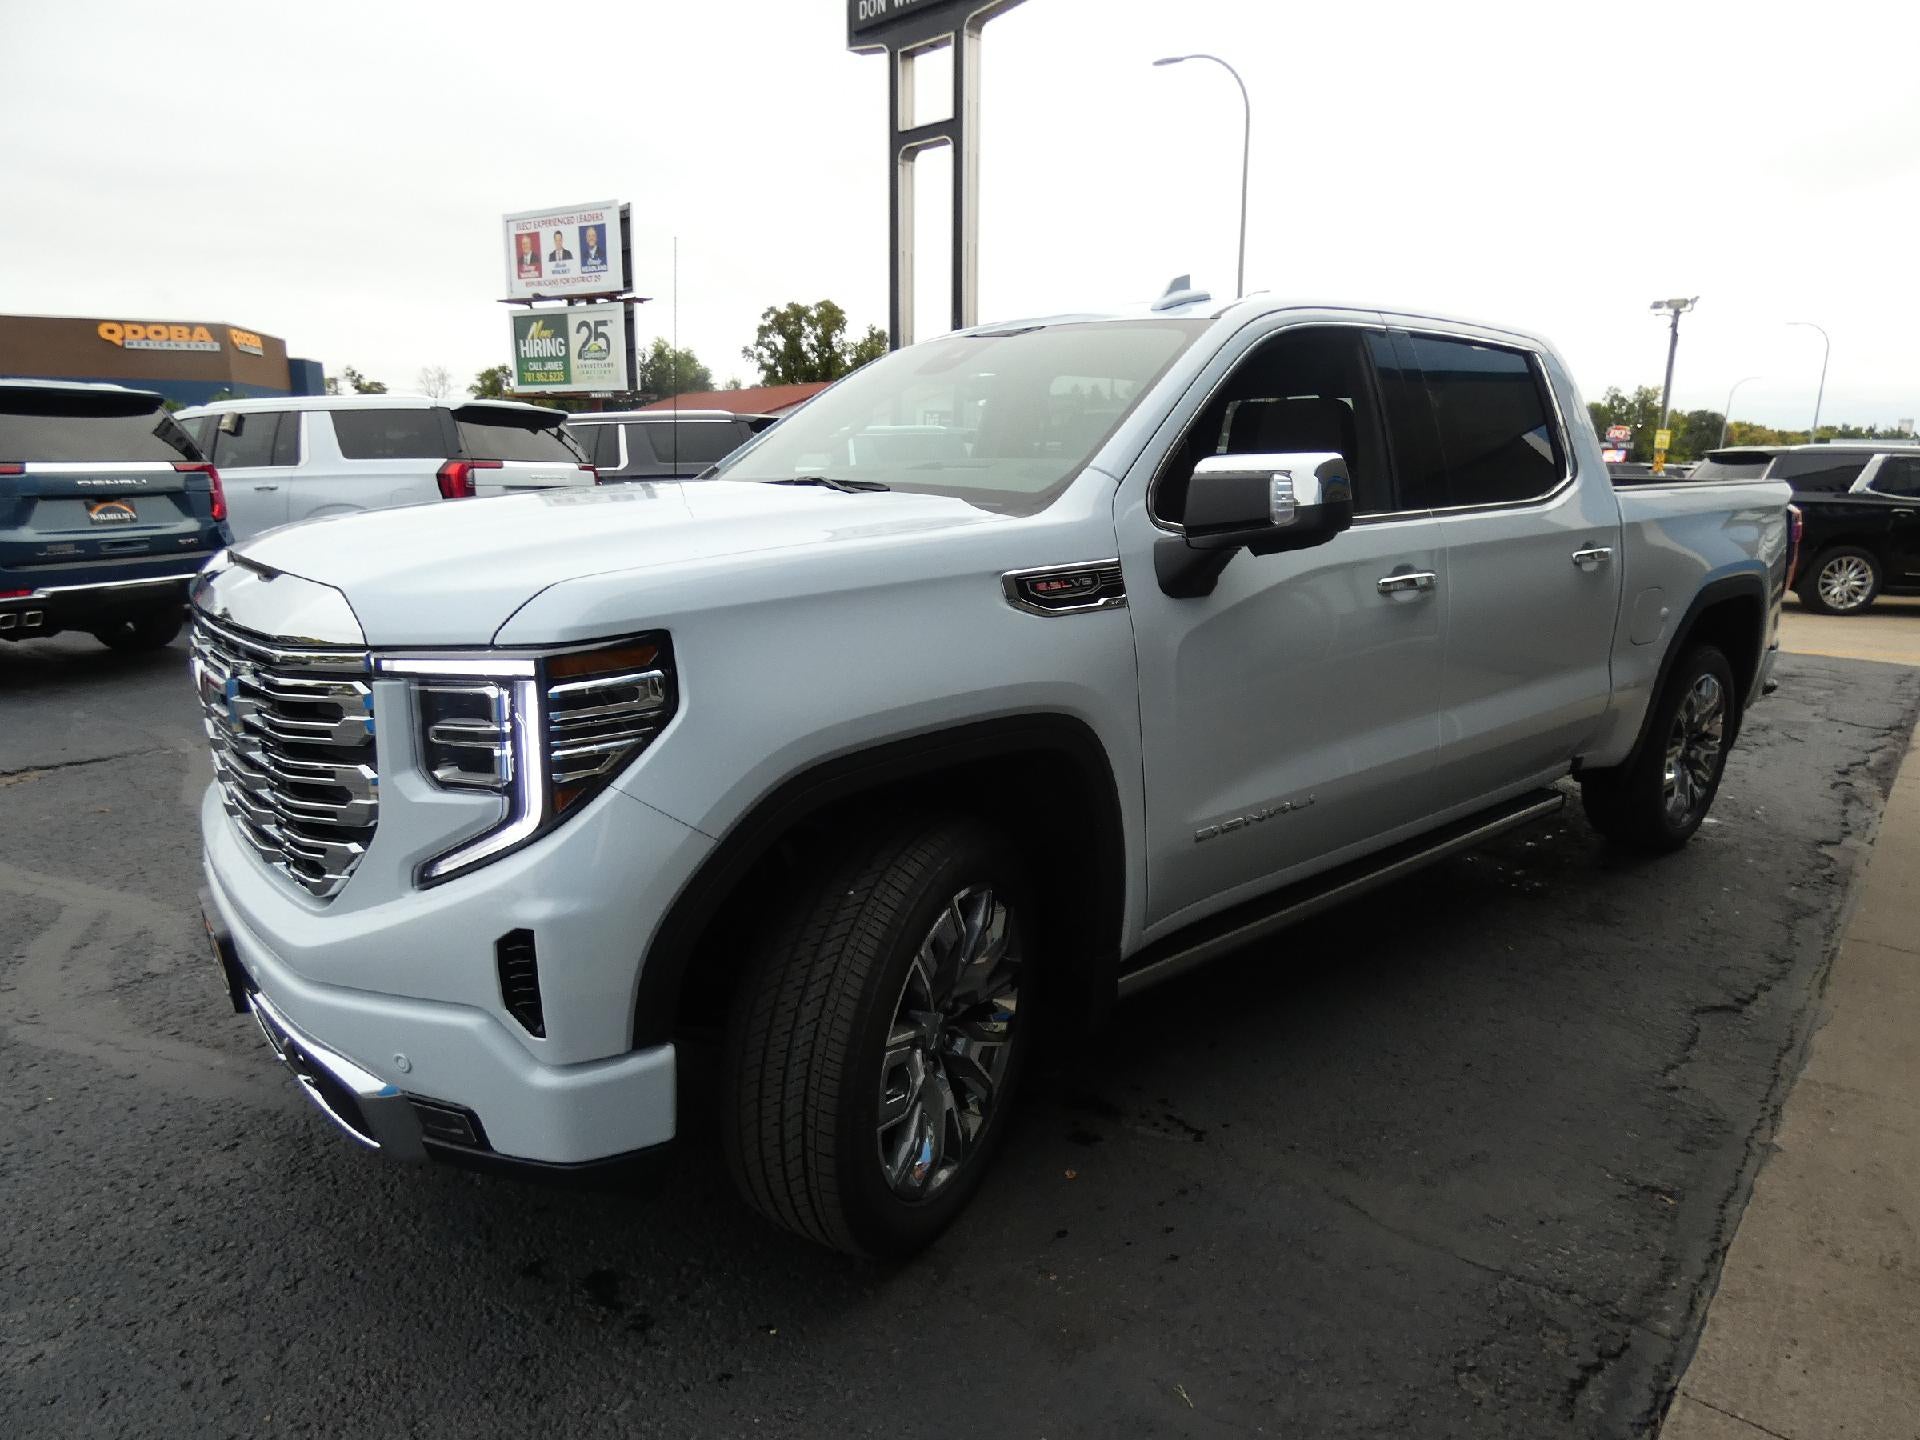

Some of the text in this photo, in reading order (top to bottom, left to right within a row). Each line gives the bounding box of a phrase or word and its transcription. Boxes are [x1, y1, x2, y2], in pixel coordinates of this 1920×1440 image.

[859, 0, 887, 21] DON
[533, 215, 576, 229] EXPERIENCED
[576, 211, 604, 224] LEADERS
[97, 321, 214, 347] QDOBA
[126, 340, 180, 349] MEXICAN
[575, 320, 611, 361] 25
[520, 337, 566, 358] HIRING
[528, 360, 564, 371] CALL JAMES
[76, 479, 148, 487] DENALI
[1194, 794, 1315, 842] DENALI
